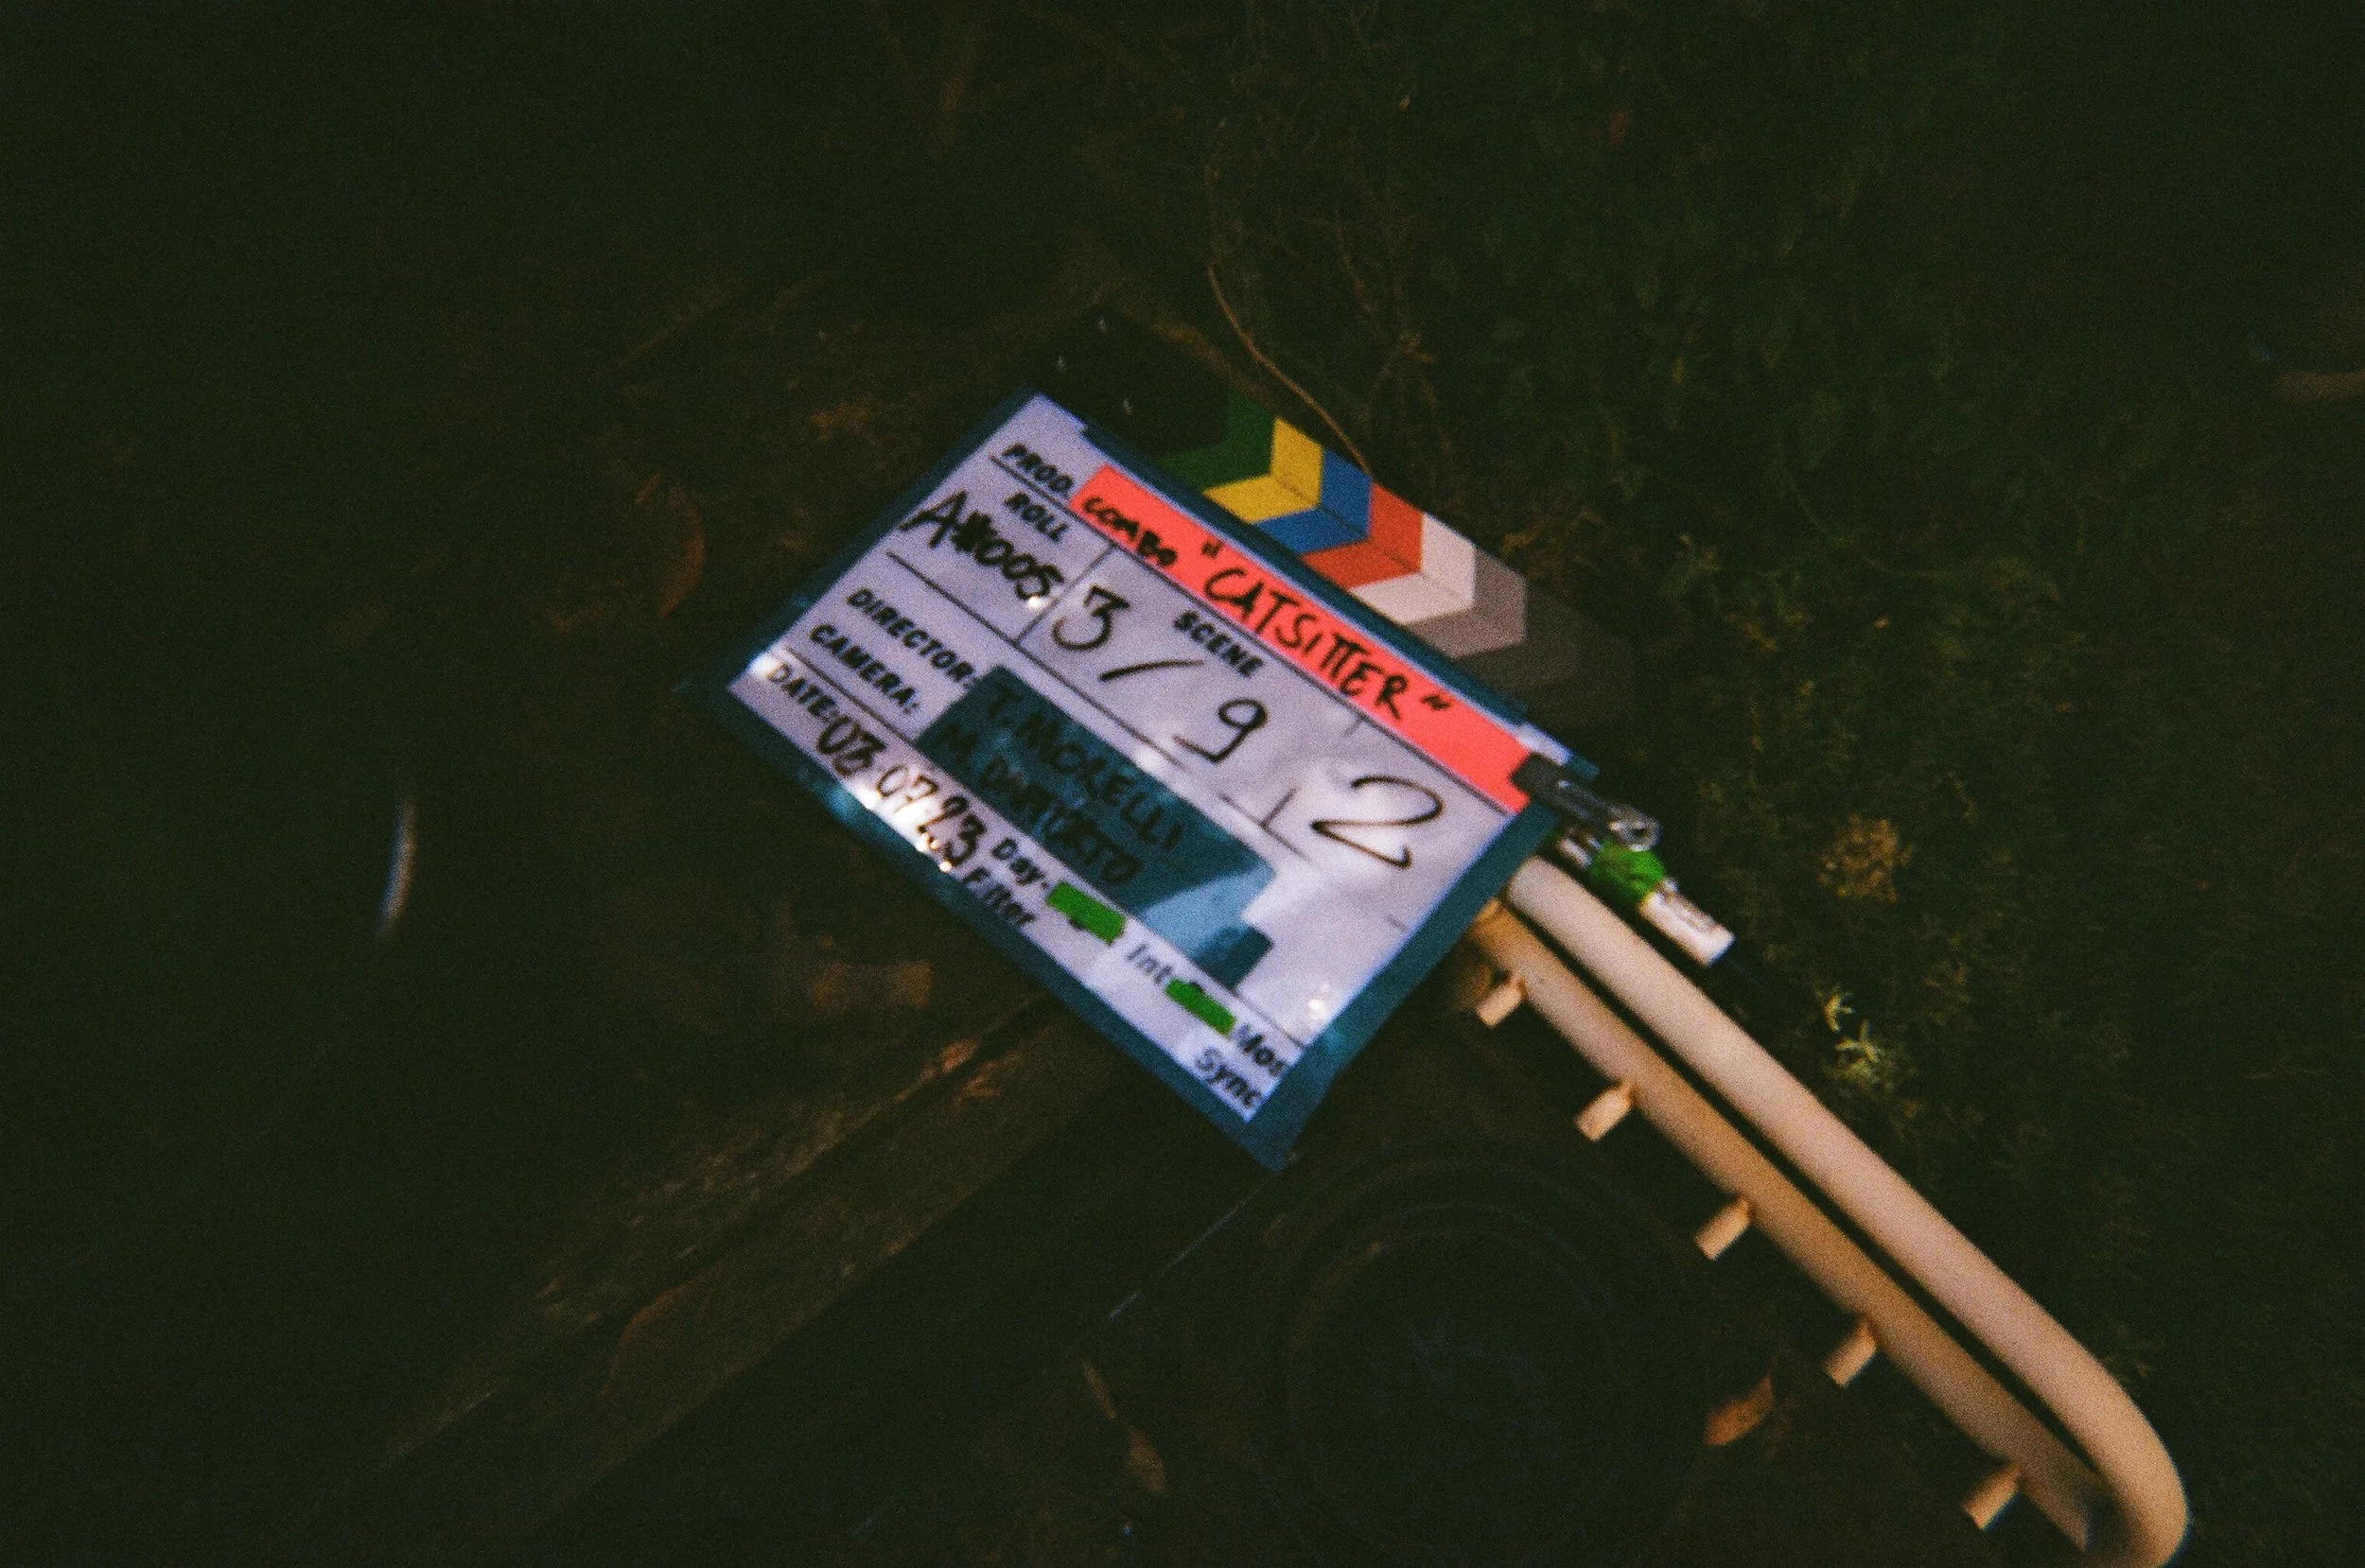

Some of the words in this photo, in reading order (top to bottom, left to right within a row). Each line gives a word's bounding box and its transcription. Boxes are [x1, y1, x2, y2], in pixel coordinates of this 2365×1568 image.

[1004, 491, 1069, 543] ROLL
[808, 621, 920, 716] CAMERA:
[846, 586, 979, 689] DIRECTOR:
[1173, 609, 1265, 680] SCENE
[1309, 773, 1445, 870] 2
